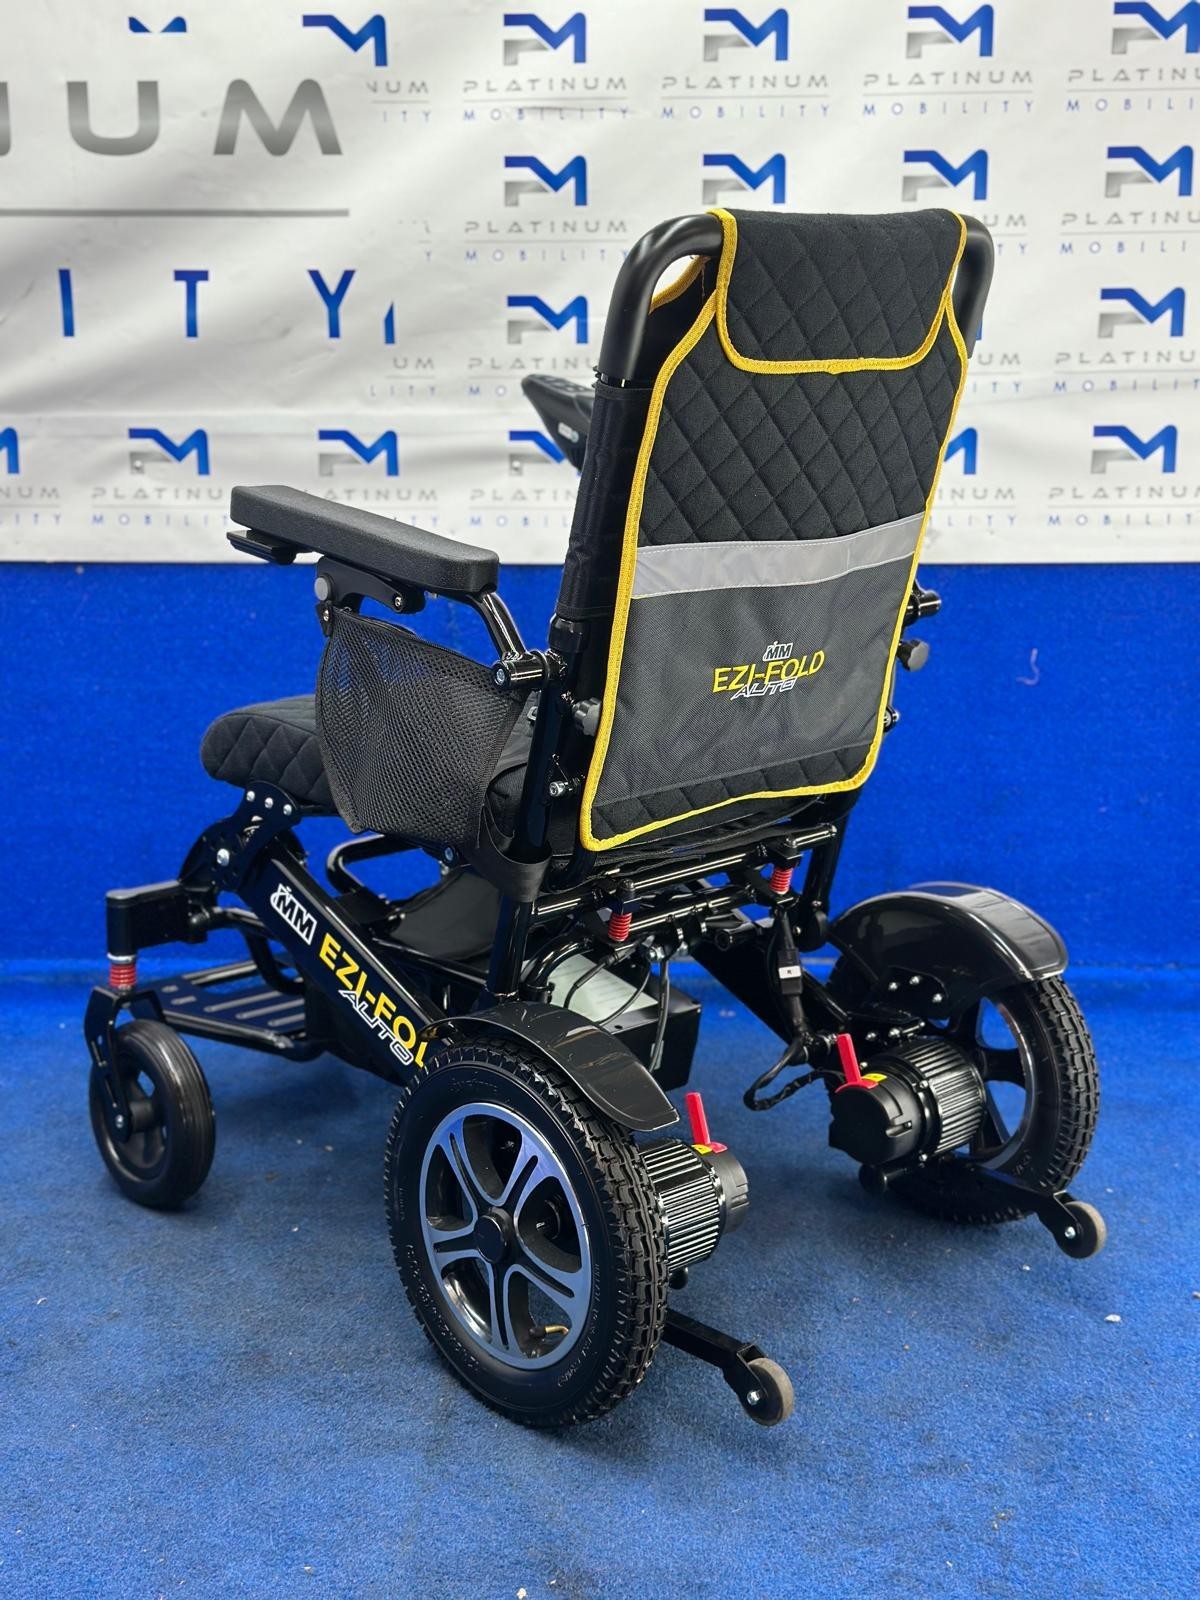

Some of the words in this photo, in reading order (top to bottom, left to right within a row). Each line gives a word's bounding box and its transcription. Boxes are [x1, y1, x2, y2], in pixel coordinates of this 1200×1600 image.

[463, 77, 627, 93] PLATINUM
[662, 75, 829, 90] PLATINUM
[864, 70, 1033, 86] PLATINUM
[463, 107, 630, 121] MOBILITY
[661, 104, 829, 119] MOBILITY
[863, 100, 1033, 116] MOBILITY
[0, 79, 342, 156] UM
[464, 220, 627, 234] PLATINUM
[304, 488, 437, 501] ATINUM
[712, 650, 825, 693] EZI-FOLD
